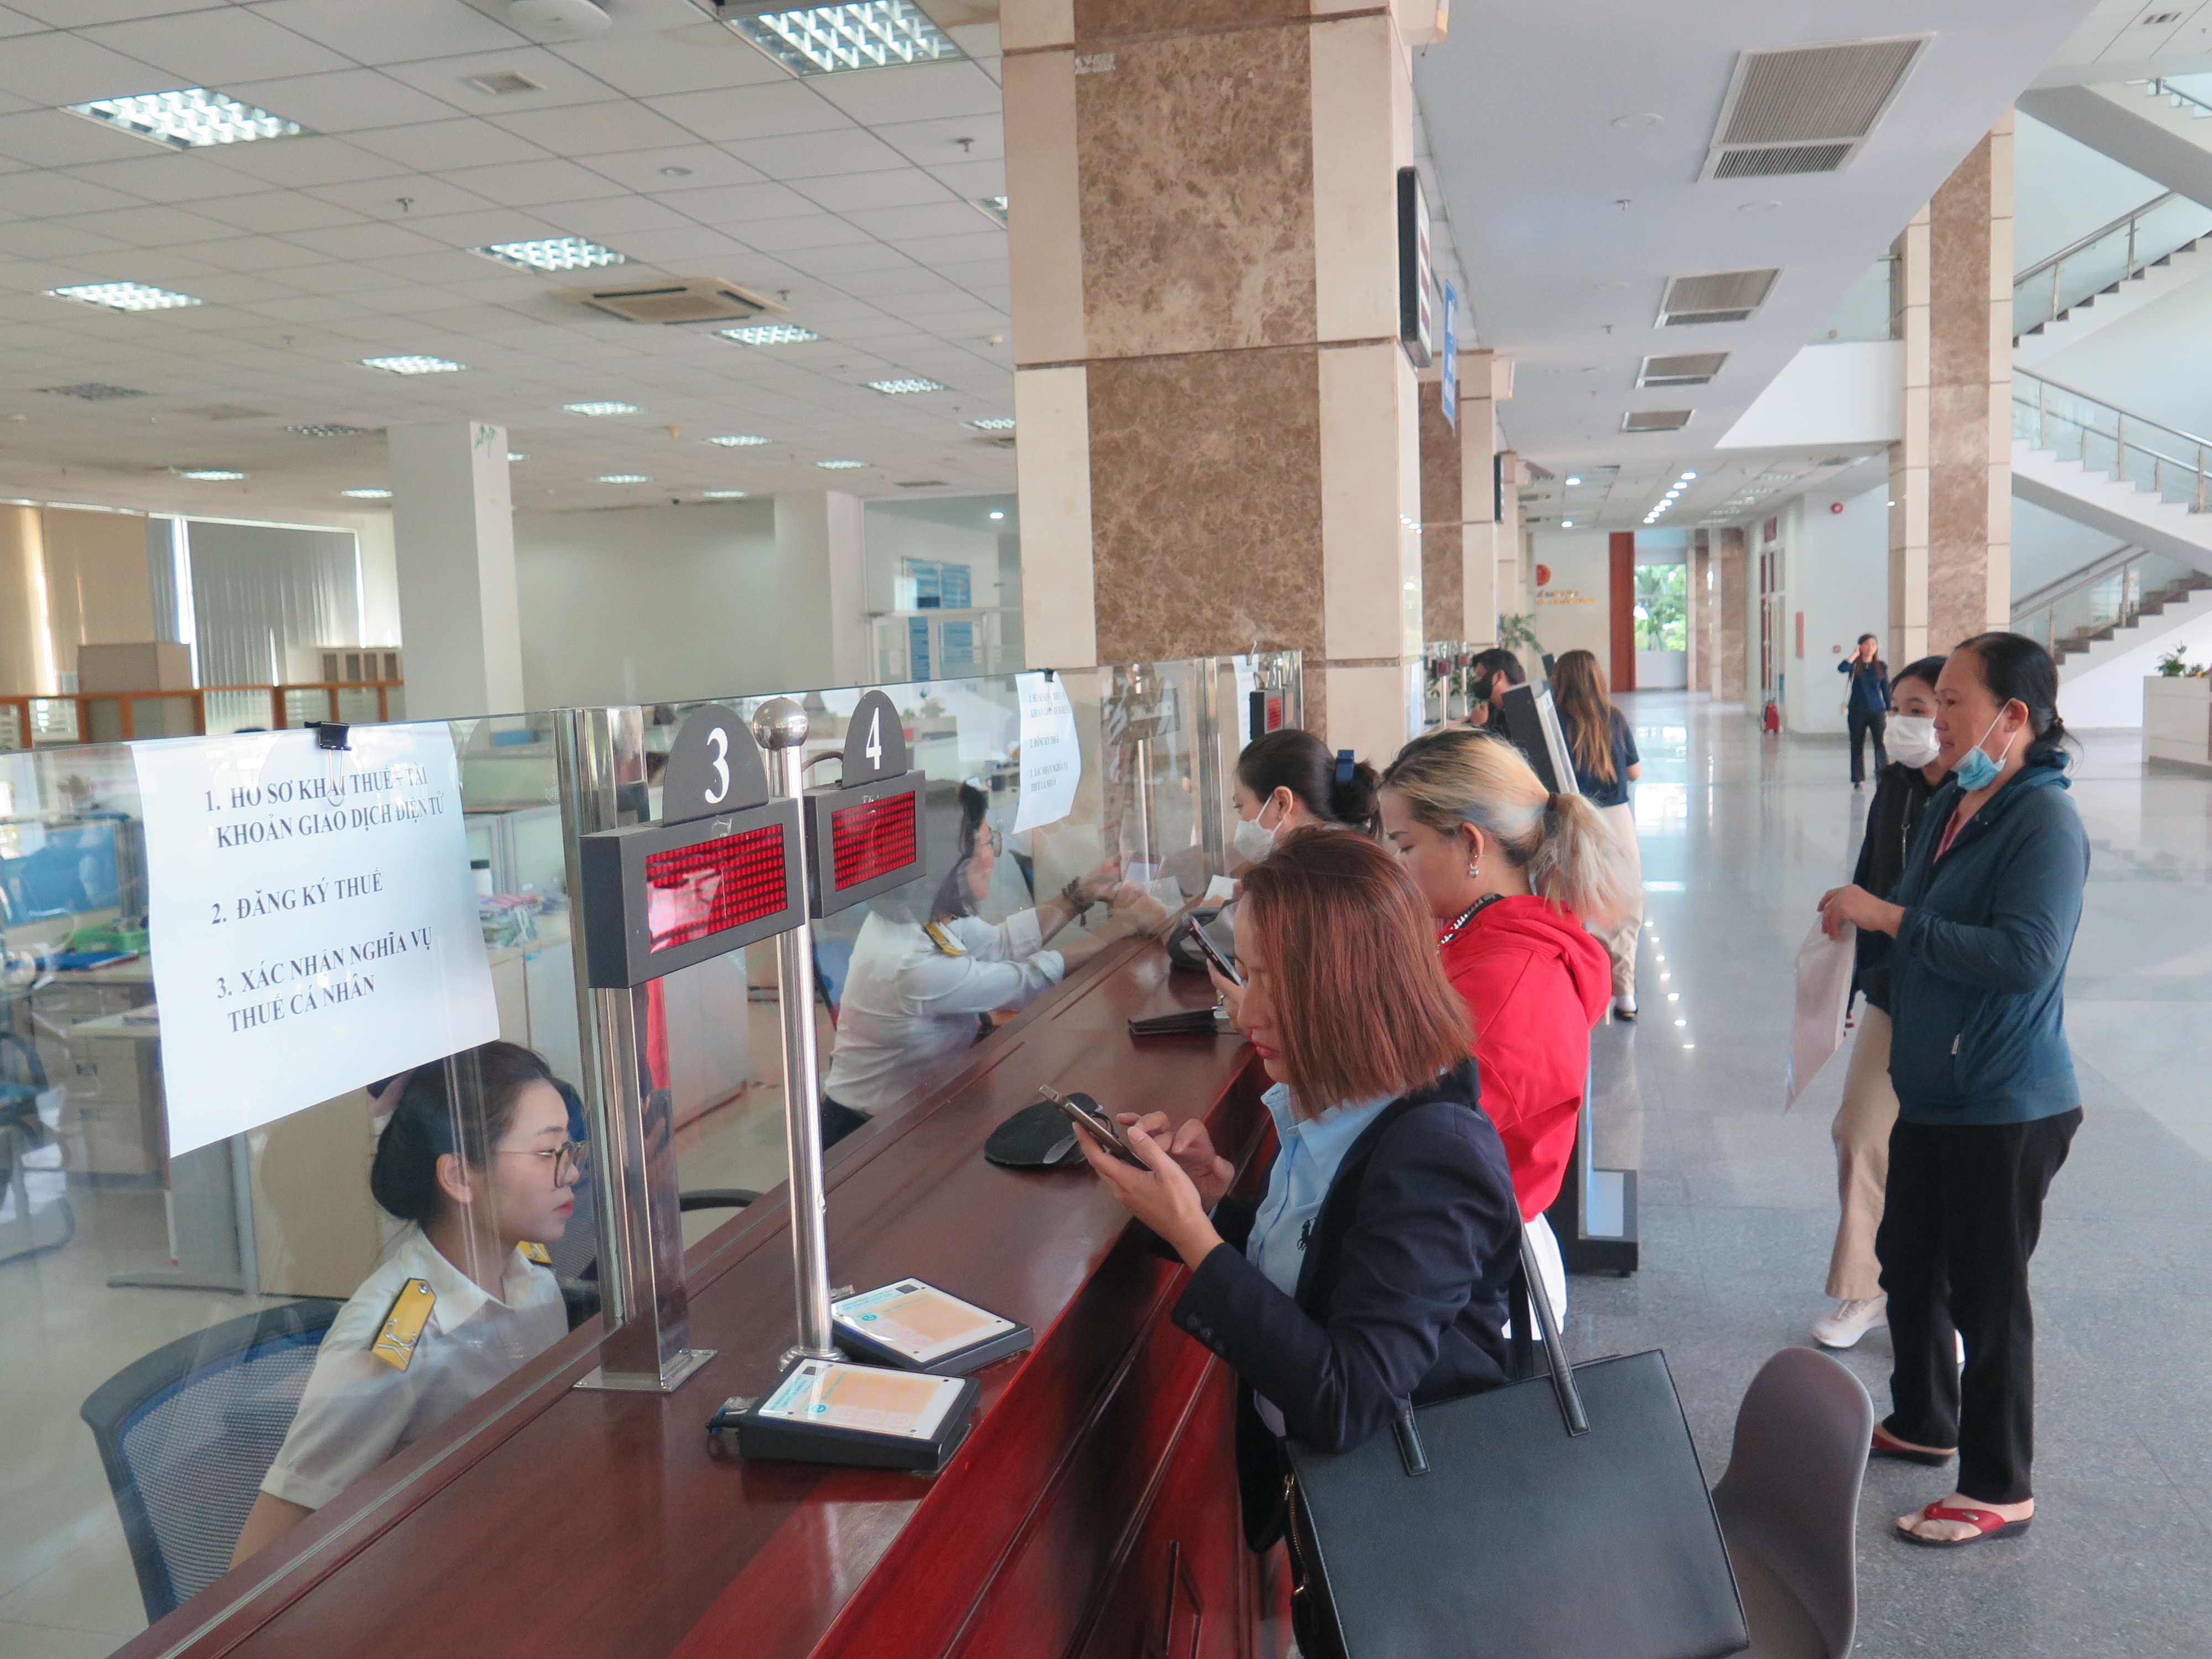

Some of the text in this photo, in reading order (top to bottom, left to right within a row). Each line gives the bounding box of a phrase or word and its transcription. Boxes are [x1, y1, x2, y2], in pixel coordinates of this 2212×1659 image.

[705, 727, 729, 804] 3
[865, 707, 881, 769] 4
[205, 790, 221, 811] 1.
[268, 780, 293, 804] SƠ
[350, 764, 393, 794] THUẾ
[406, 761, 428, 786] TÀI
[216, 790, 444, 848] KHOẢN GIAO DỊCH ĐIỆN TỬ
[212, 867, 383, 925] 2. ĐĂNG KÝ THUẾ
[217, 926, 432, 998] 3. XÁC NHẬN NGHĨA VỤ
[227, 973, 375, 1032] THUẾ CÁ NHÂN
